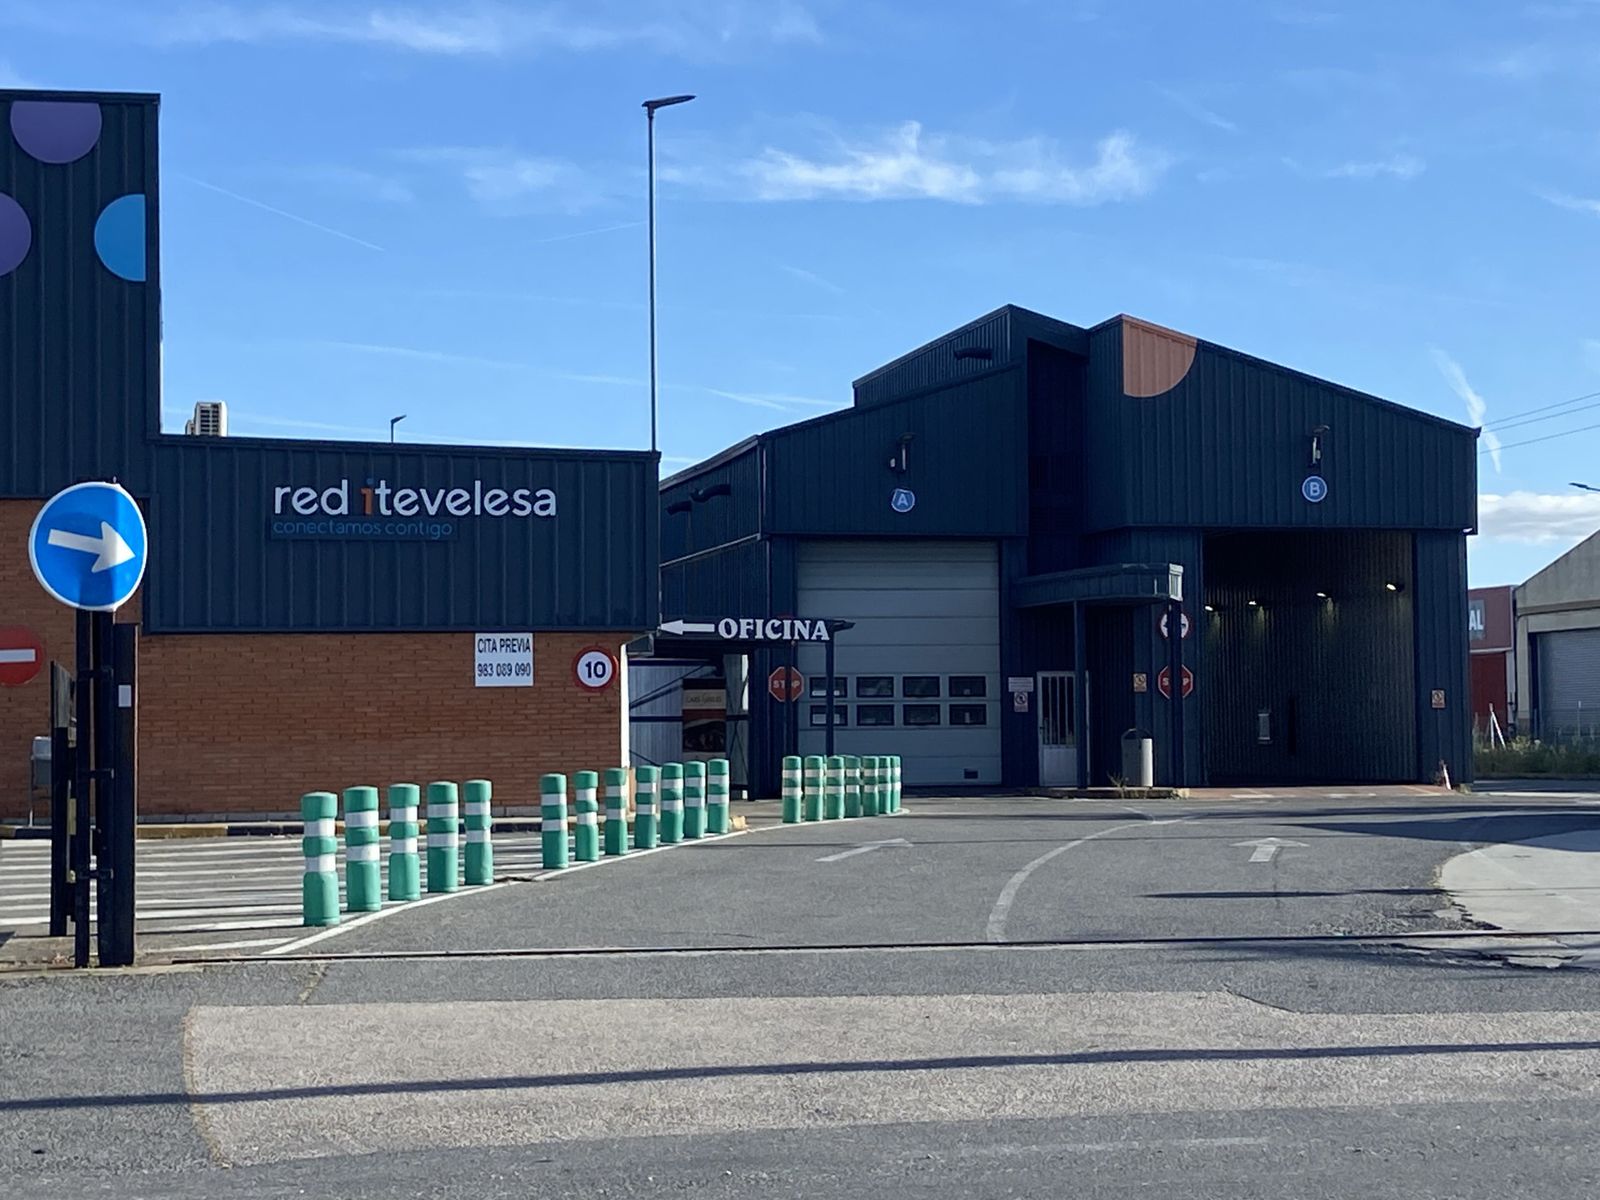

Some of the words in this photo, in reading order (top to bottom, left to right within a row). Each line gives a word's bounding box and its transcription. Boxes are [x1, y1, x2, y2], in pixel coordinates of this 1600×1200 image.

[274, 479, 349, 516] red
[361, 477, 557, 516] itevelesa
[1309, 481, 1320, 497] B
[896, 493, 909, 507] A
[272, 519, 381, 535] conectamos
[384, 520, 453, 540] contigo
[717, 617, 831, 642] OFICINA
[477, 638, 498, 653] CITA
[499, 638, 531, 653] PREVIA
[477, 663, 494, 677] 983
[514, 662, 531, 677] 090
[585, 661, 606, 679] 10
[773, 679, 801, 689] STP
[1162, 677, 1190, 686] SP
